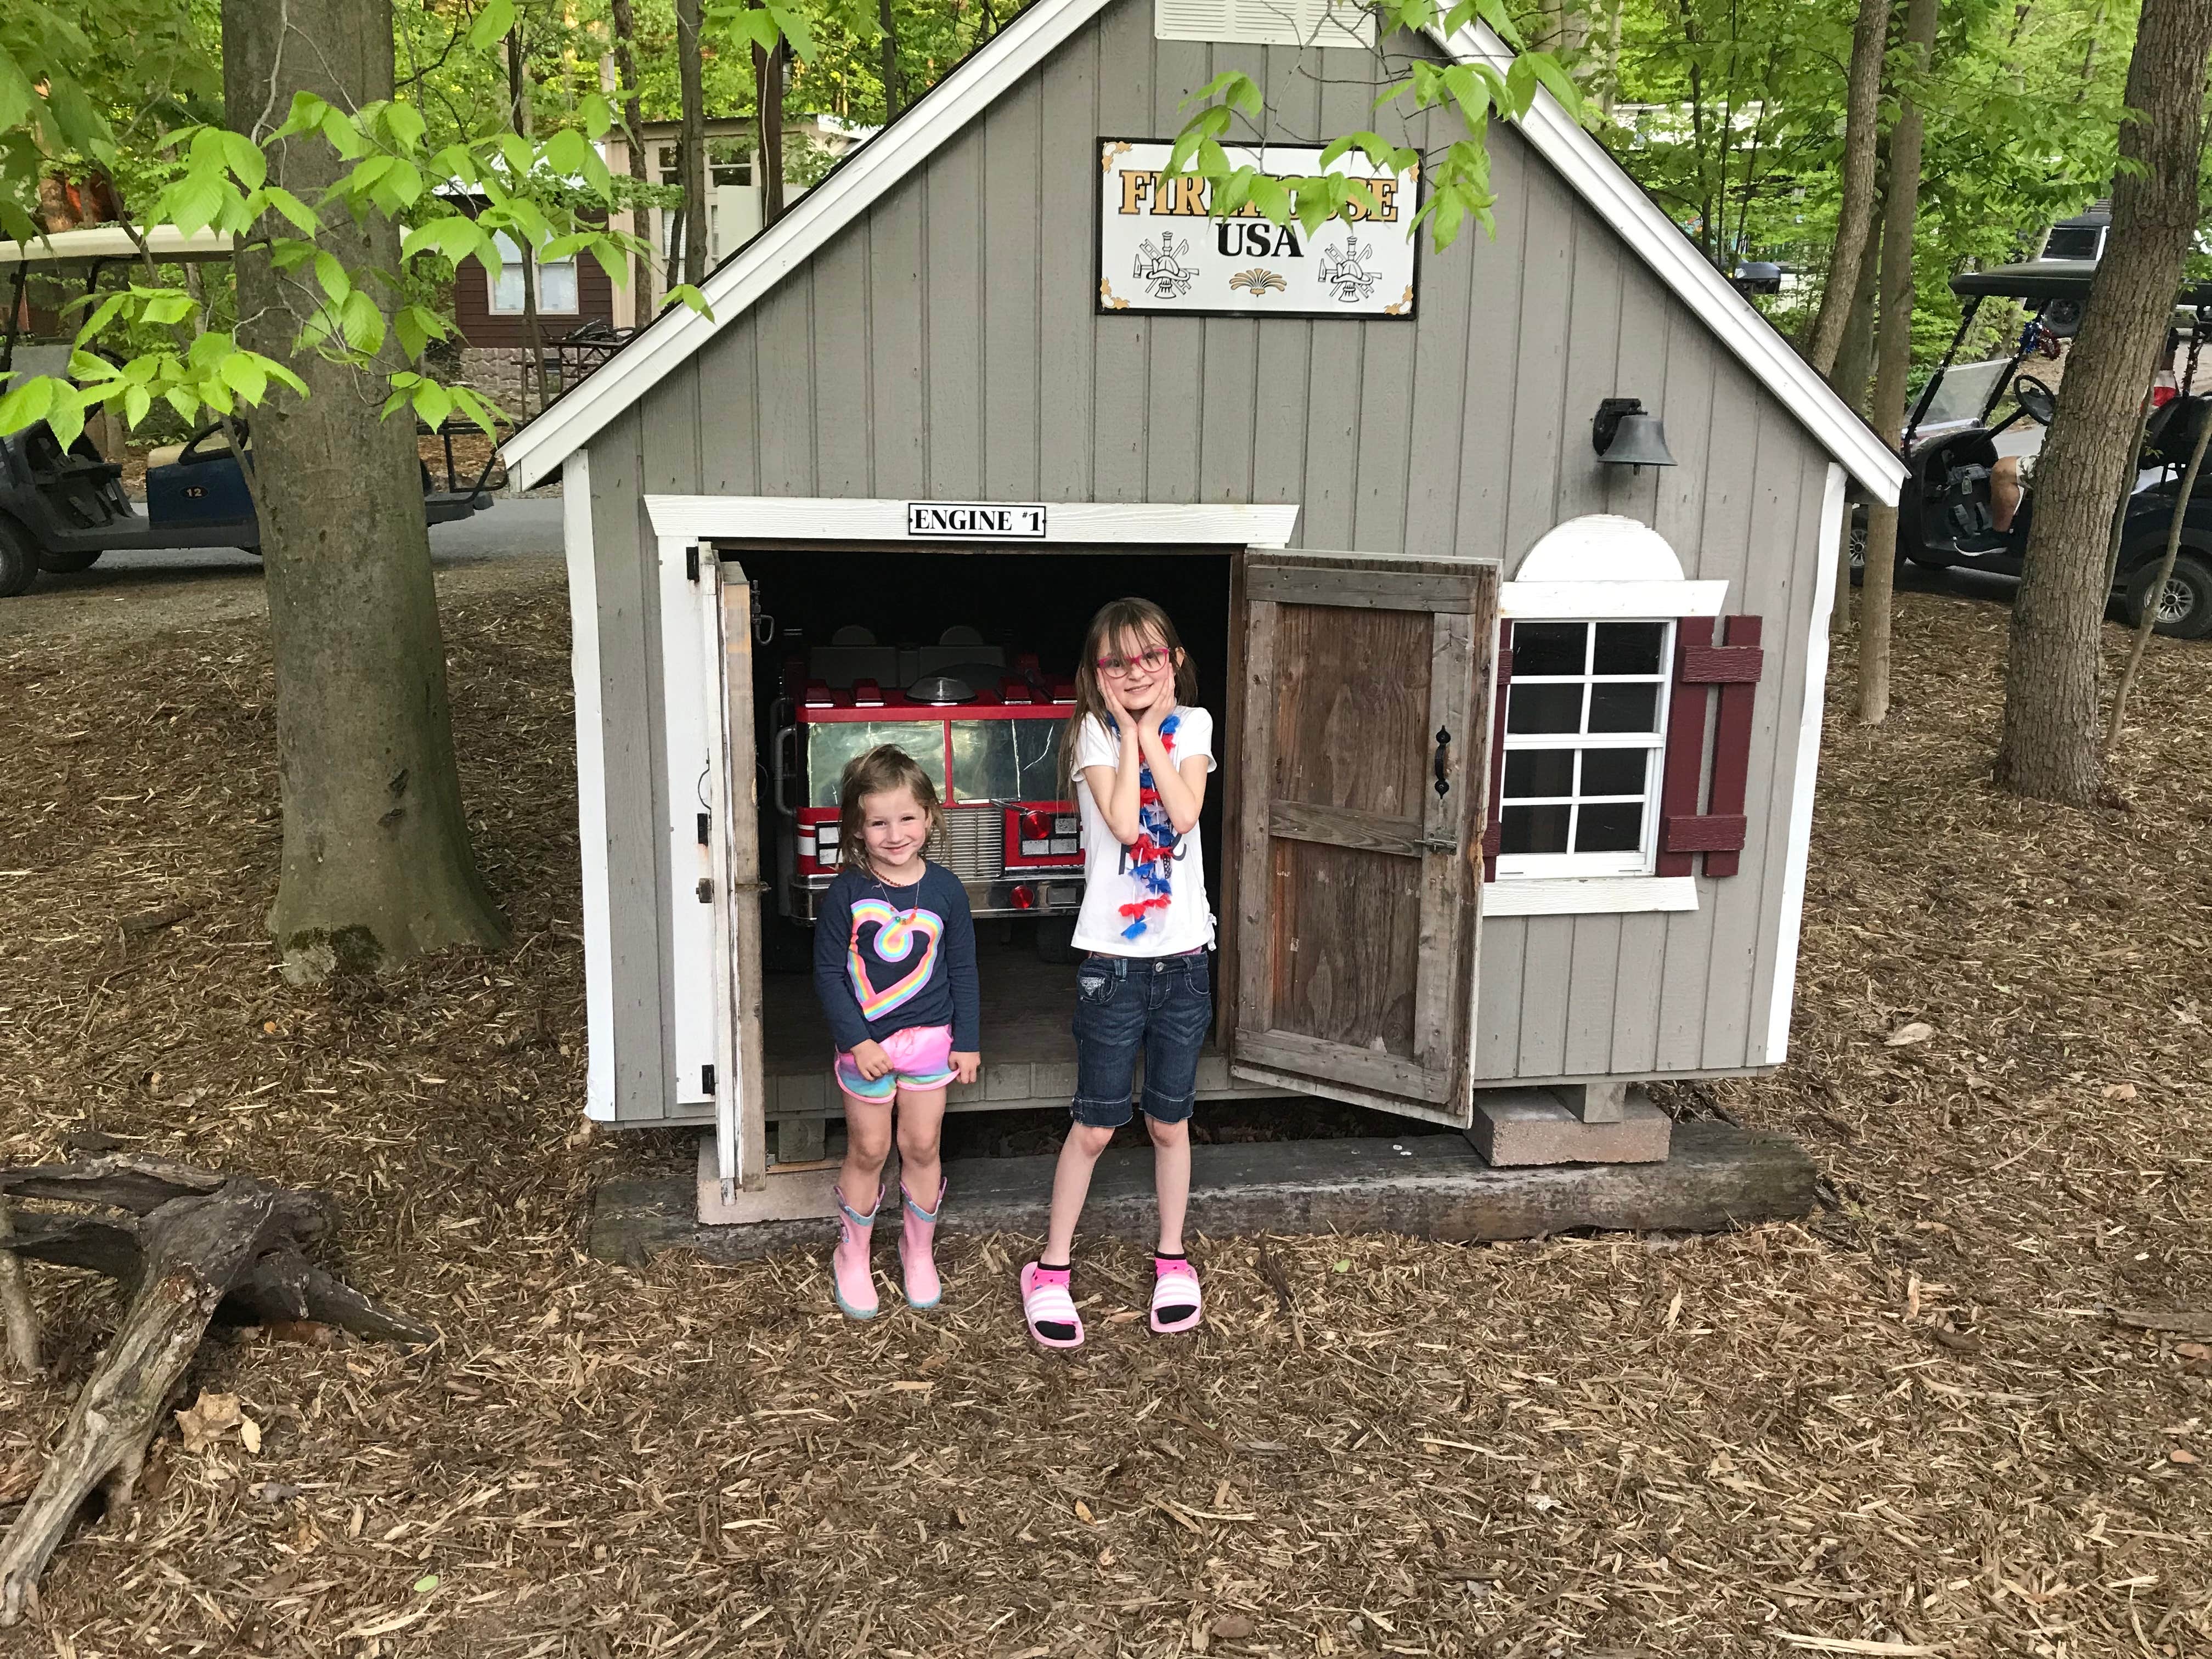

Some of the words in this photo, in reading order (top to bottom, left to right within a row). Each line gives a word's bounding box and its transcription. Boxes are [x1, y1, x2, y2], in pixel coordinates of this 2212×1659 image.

[1215, 223, 1305, 257] USA
[187, 488, 202, 496] 12
[914, 509, 1013, 531] ENGINE
[1022, 511, 1041, 532] #1
